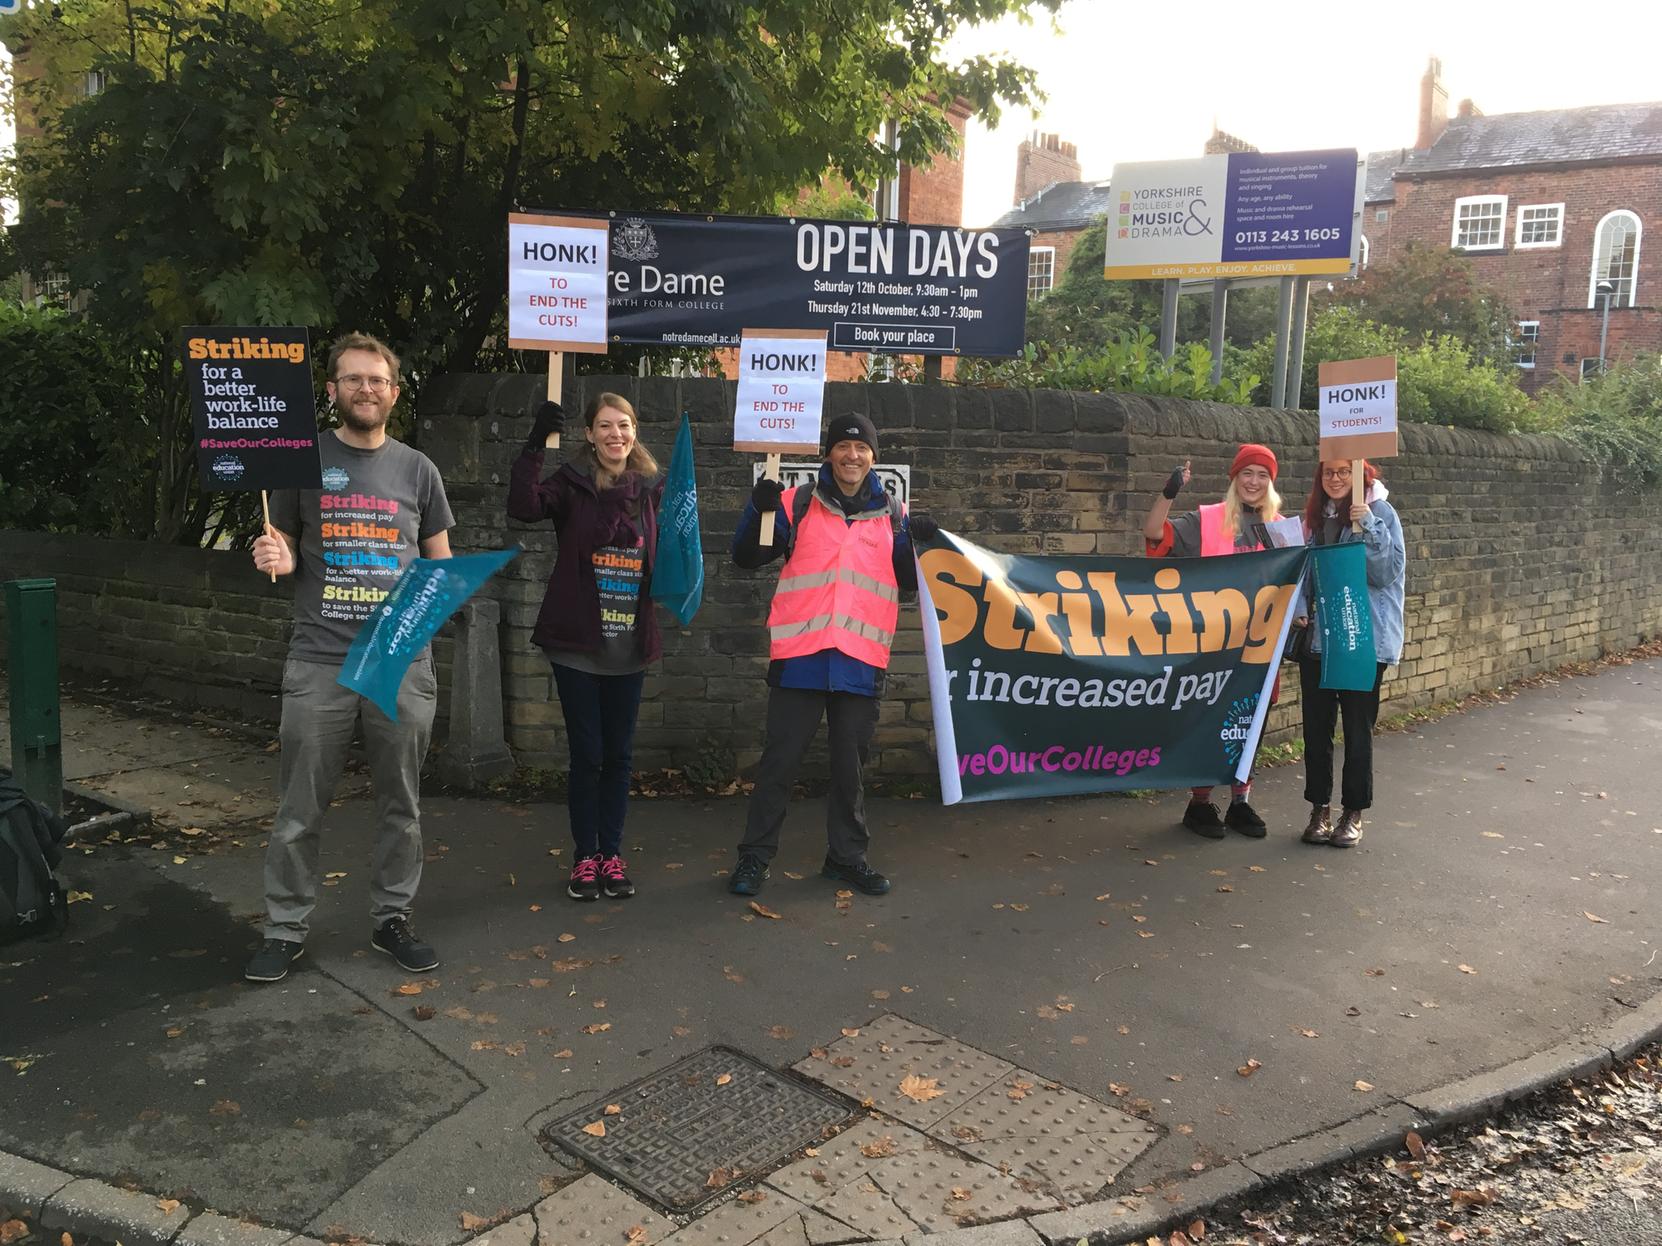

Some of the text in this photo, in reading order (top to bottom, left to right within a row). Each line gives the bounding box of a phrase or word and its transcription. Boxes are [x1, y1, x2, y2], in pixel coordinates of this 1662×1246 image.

[1280, 166, 1298, 174] group
[1298, 164, 1318, 172] tuition
[1134, 186, 1203, 200] YORKSHIRE
[1132, 200, 1184, 210] COLLEGE of
[1132, 199, 1214, 236] MUSIC &
[1132, 226, 1182, 238] DRAMA
[1236, 228, 1340, 244] 0113 243 1605
[523, 242, 597, 264] HONK!
[797, 224, 1000, 279] OPEN DAYS
[1251, 264, 1296, 272] ACHIEVE.
[550, 278, 568, 290] TO
[641, 266, 724, 296] Dame
[814, 280, 854, 295] Saturday
[856, 282, 875, 294] 12th
[878, 284, 914, 296] October,
[916, 286, 948, 297] 9:30am
[960, 286, 978, 299] 1pm
[530, 296, 588, 309] END THE
[644, 300, 673, 308] FORM
[678, 300, 724, 310] COLLEGE
[808, 300, 849, 316] Thursday
[851, 303, 870, 315] 21st
[872, 304, 919, 318] November,
[921, 306, 940, 318] 4:30
[950, 307, 982, 321] 7:30pm
[539, 314, 578, 327] CUTS!
[854, 328, 935, 345] Book your place
[188, 338, 304, 364] Striking
[751, 354, 816, 372] HONK!
[202, 363, 243, 380] for a
[204, 380, 256, 396] better
[772, 384, 788, 394] TO
[1328, 384, 1386, 404] HONK!
[205, 396, 286, 412] work-life
[754, 402, 804, 412] END THE
[207, 414, 279, 429] balance
[760, 418, 796, 430] CUTS!
[1332, 416, 1382, 428] STUDENTS!
[200, 438, 313, 449] #SaveOurColleges
[320, 494, 400, 514] Striking
[320, 510, 394, 522] for increased pay
[321, 522, 400, 542] Striking
[322, 540, 334, 548] for
[334, 540, 368, 548] smaller
[368, 540, 388, 548] class
[324, 550, 400, 570] Striking
[592, 553, 642, 571] triking
[324, 575, 356, 583] balance
[594, 568, 616, 576] maller
[322, 585, 390, 602] Strikin
[597, 578, 640, 595] riking
[354, 604, 368, 612] the
[917, 548, 1297, 664] Striking
[321, 610, 354, 620] College
[602, 608, 636, 625] king
[1340, 606, 1348, 630] union
[1343, 586, 1356, 652] education
[1352, 602, 1362, 634] national
[967, 657, 1172, 708] increased
[1170, 668, 1233, 711] pay
[958, 743, 1162, 776] veOurColleges
